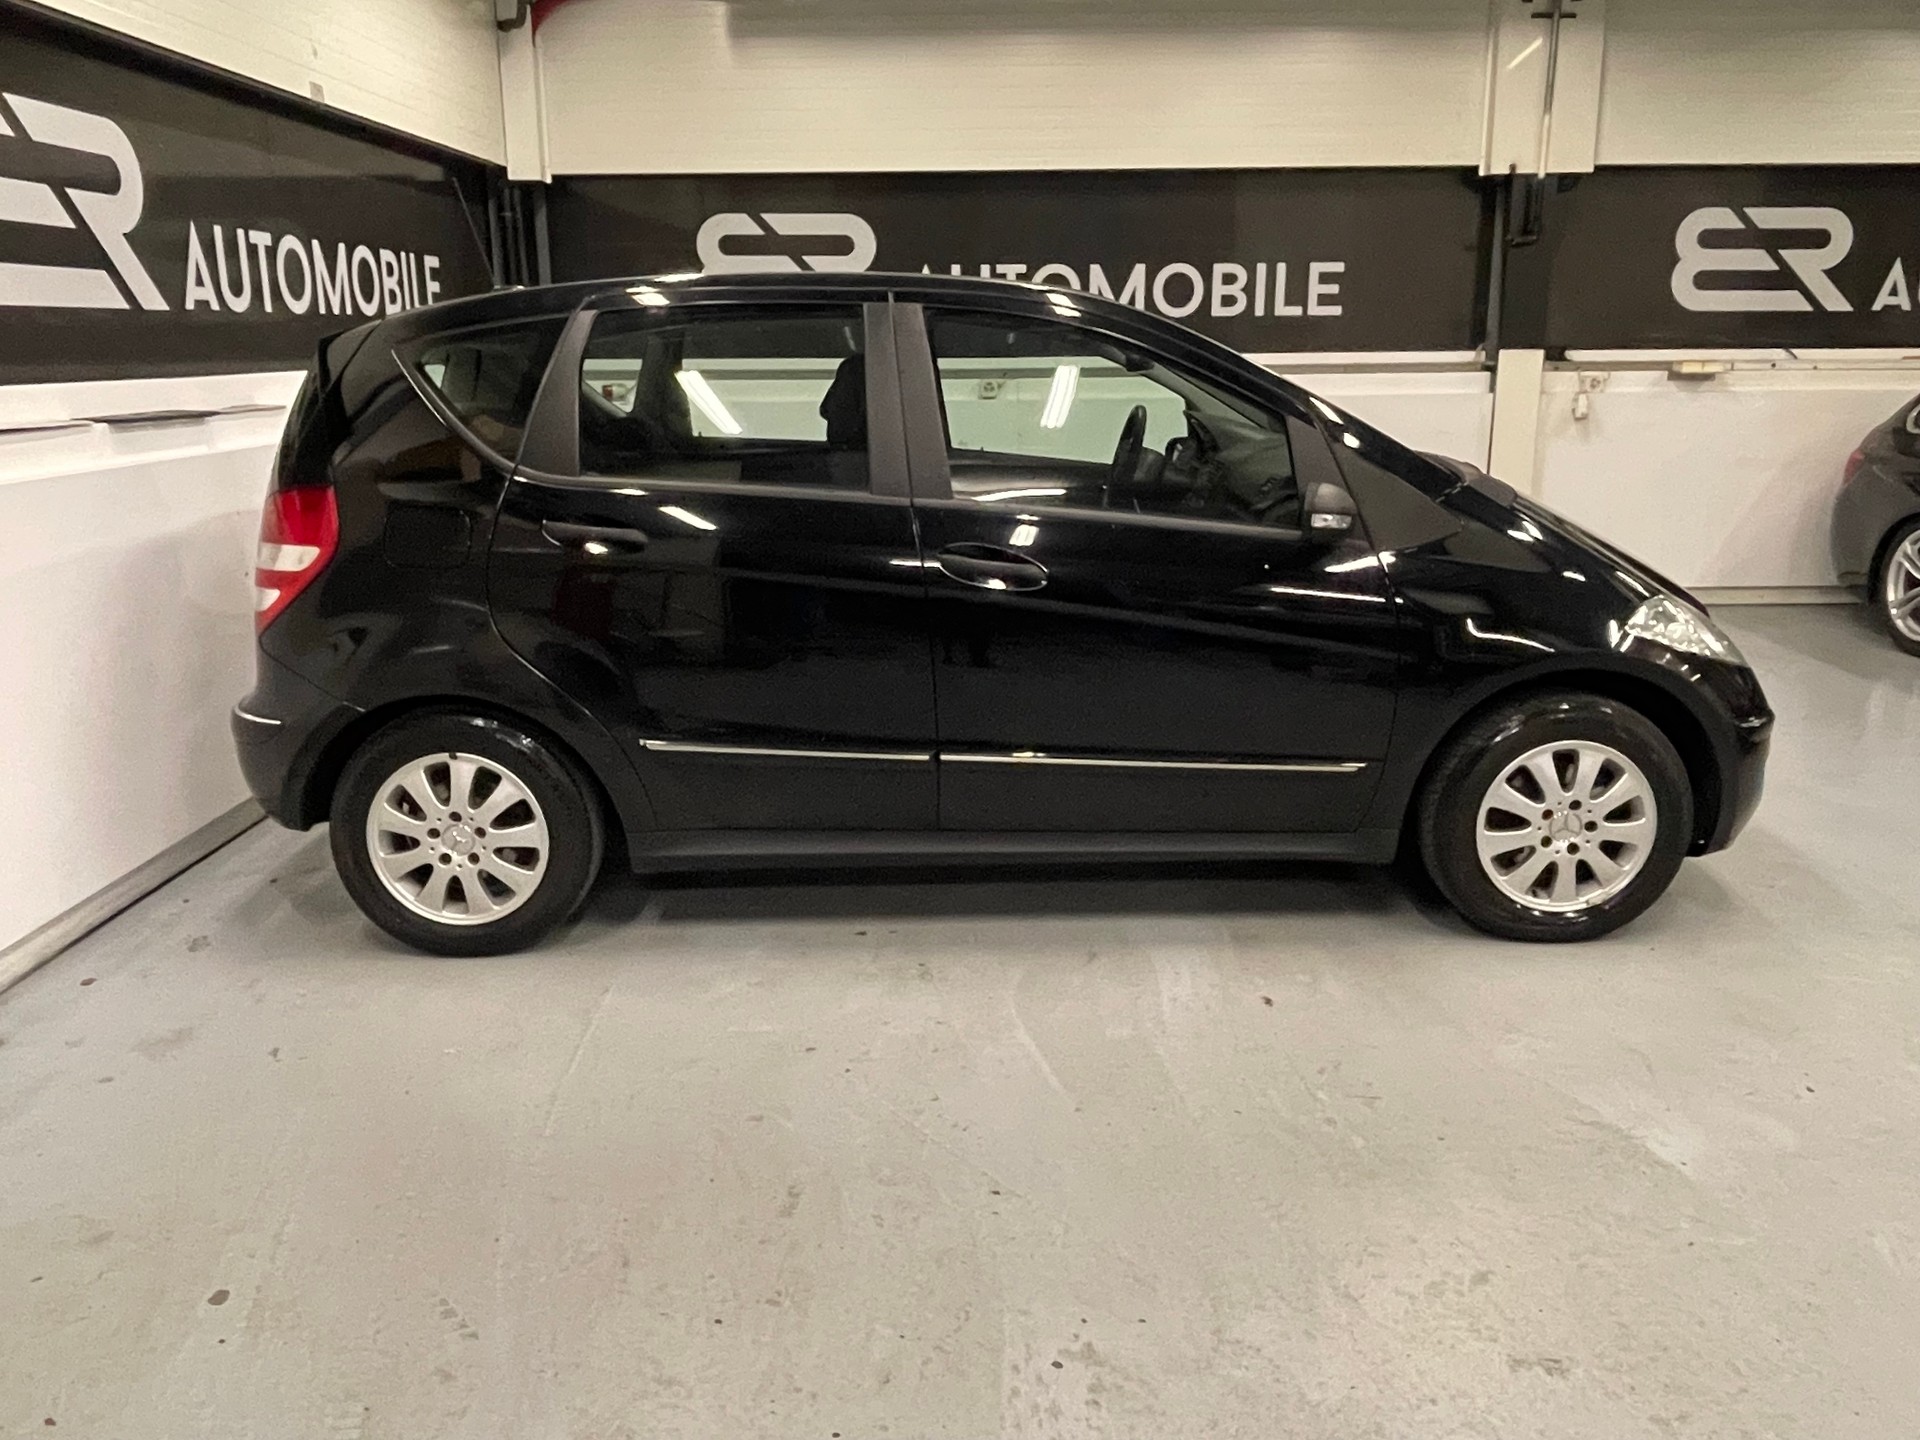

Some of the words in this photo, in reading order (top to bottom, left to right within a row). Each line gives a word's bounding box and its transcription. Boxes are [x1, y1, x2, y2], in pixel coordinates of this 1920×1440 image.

[184, 219, 441, 316] AUTOMOBILE
[921, 261, 1346, 318] MOBILE
[1670, 206, 1854, 312] ER
[1871, 256, 1920, 312] A
